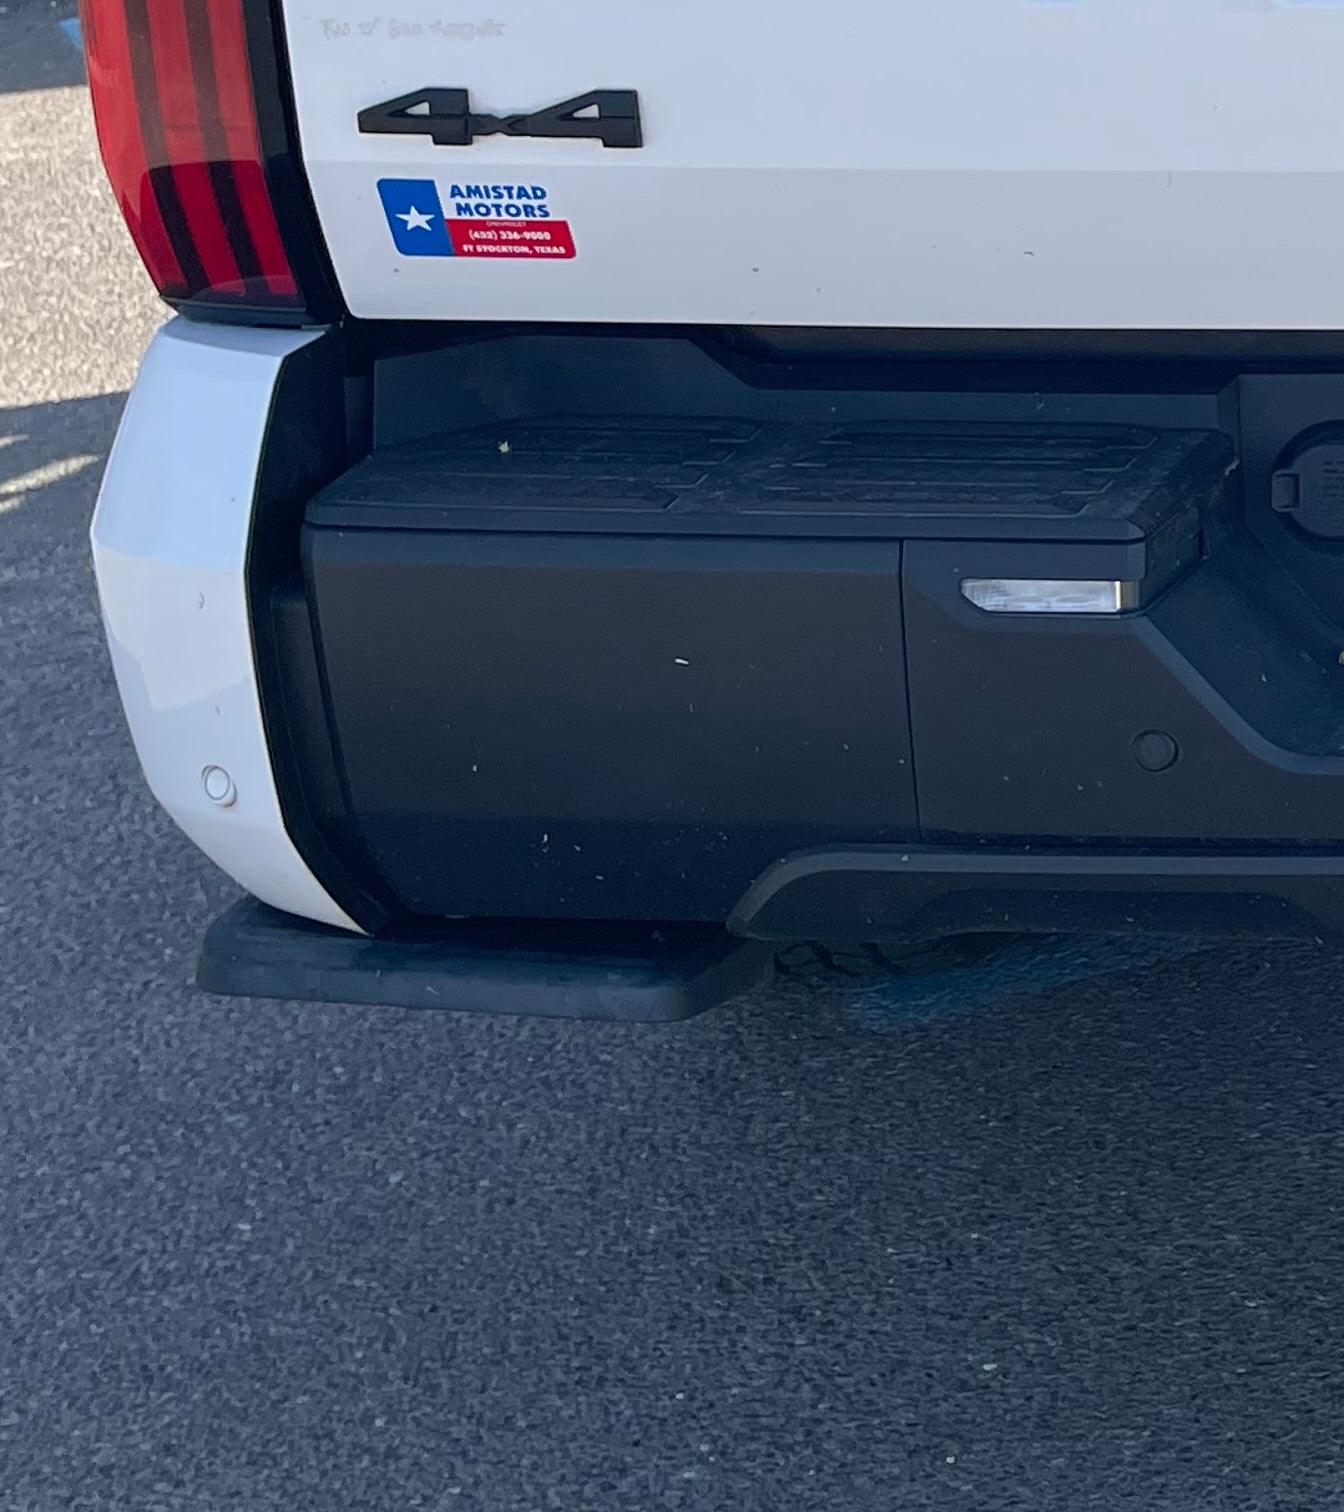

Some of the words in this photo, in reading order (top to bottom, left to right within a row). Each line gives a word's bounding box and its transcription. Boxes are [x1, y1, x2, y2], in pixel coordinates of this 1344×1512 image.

[450, 184, 548, 201] AMISTAD
[456, 202, 550, 218] MOTORS
[476, 244, 533, 254] STOCKTON,
[534, 245, 567, 254] TEXAS
